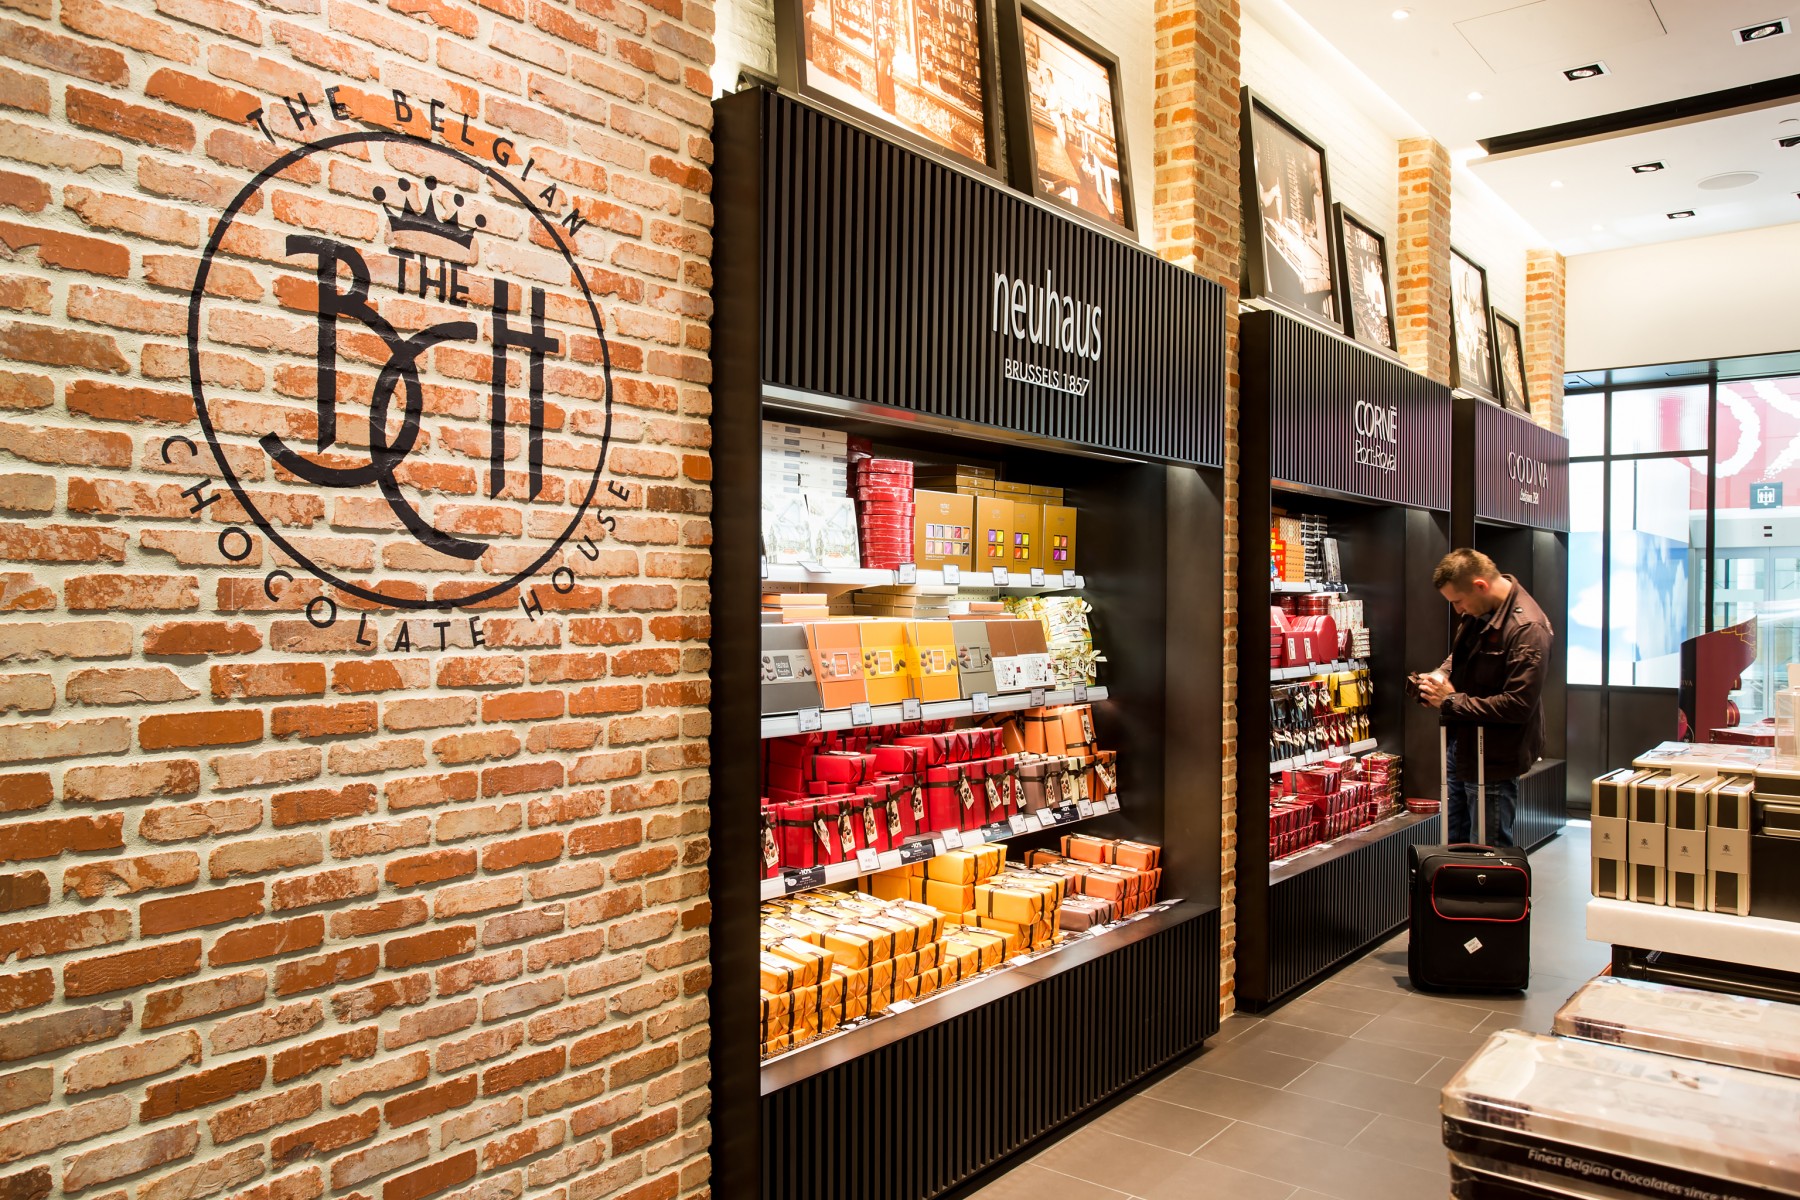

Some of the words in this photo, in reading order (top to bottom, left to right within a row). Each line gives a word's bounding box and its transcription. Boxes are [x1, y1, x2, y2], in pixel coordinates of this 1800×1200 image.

[246, 85, 353, 145] THE
[394, 89, 588, 235] BELGIAN
[388, 248, 470, 306] THE
[992, 269, 1102, 361] neuhaus
[1005, 358, 1059, 389] BRUSSELS
[1063, 373, 1090, 396] 1857
[1508, 451, 1549, 489] GODIVA
[161, 434, 486, 652] CHOCOLATE
[520, 480, 630, 622] HOUSE
[1527, 1149, 1563, 1167] Finest
[1564, 1157, 1610, 1177] Belgian
[1611, 1168, 1682, 1196] Chocolates
